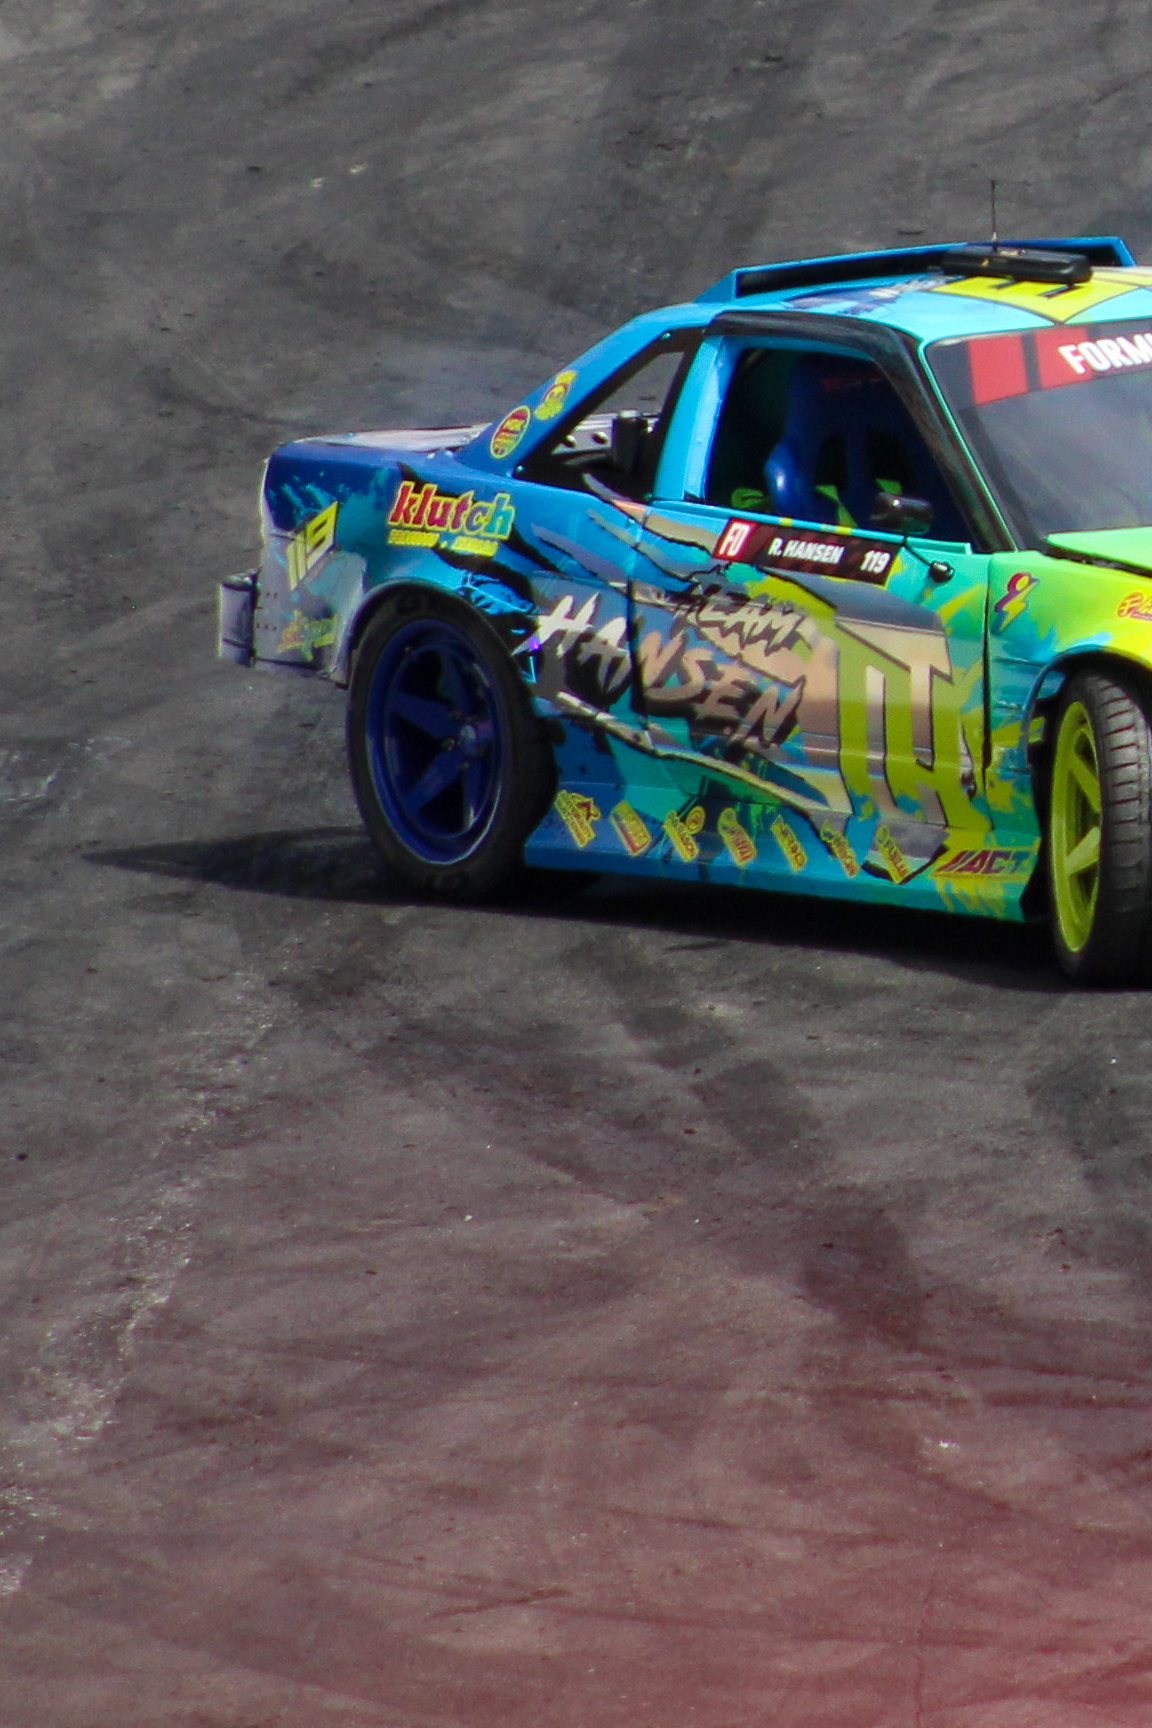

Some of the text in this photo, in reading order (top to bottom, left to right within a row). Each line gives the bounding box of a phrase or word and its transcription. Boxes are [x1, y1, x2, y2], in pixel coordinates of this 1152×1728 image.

[388, 481, 515, 540] klutch
[768, 536, 783, 555] R.
[784, 540, 845, 564] HANSEN
[860, 550, 891, 574] 119
[511, 592, 806, 747] HANSEN
